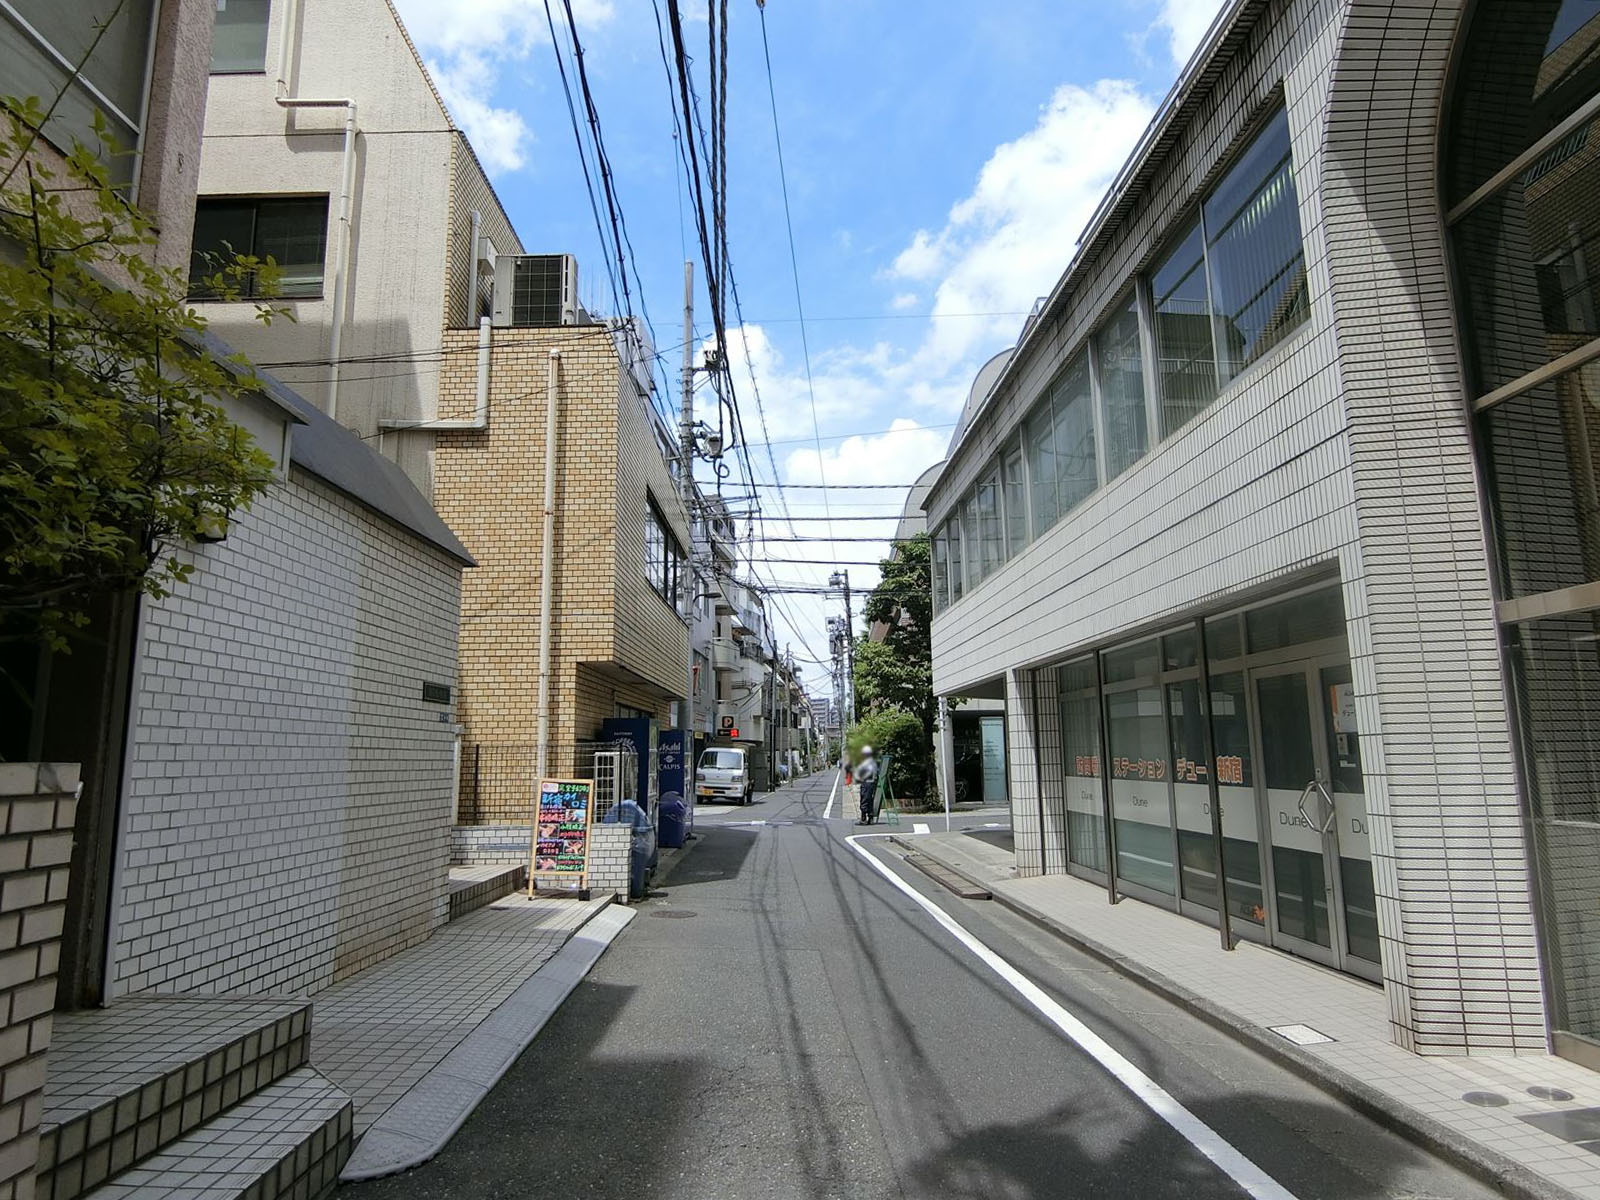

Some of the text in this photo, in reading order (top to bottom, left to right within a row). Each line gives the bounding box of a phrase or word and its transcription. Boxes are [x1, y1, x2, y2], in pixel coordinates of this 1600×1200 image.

[1112, 757, 1166, 779] ステーション
[1177, 757, 1208, 782] デュー
[1216, 755, 1243, 783] 新宿
[1132, 795, 1149, 808] Dune
[1203, 803, 1225, 817] De
[1279, 811, 1308, 828] Dune
[1351, 818, 1370, 835] Du
